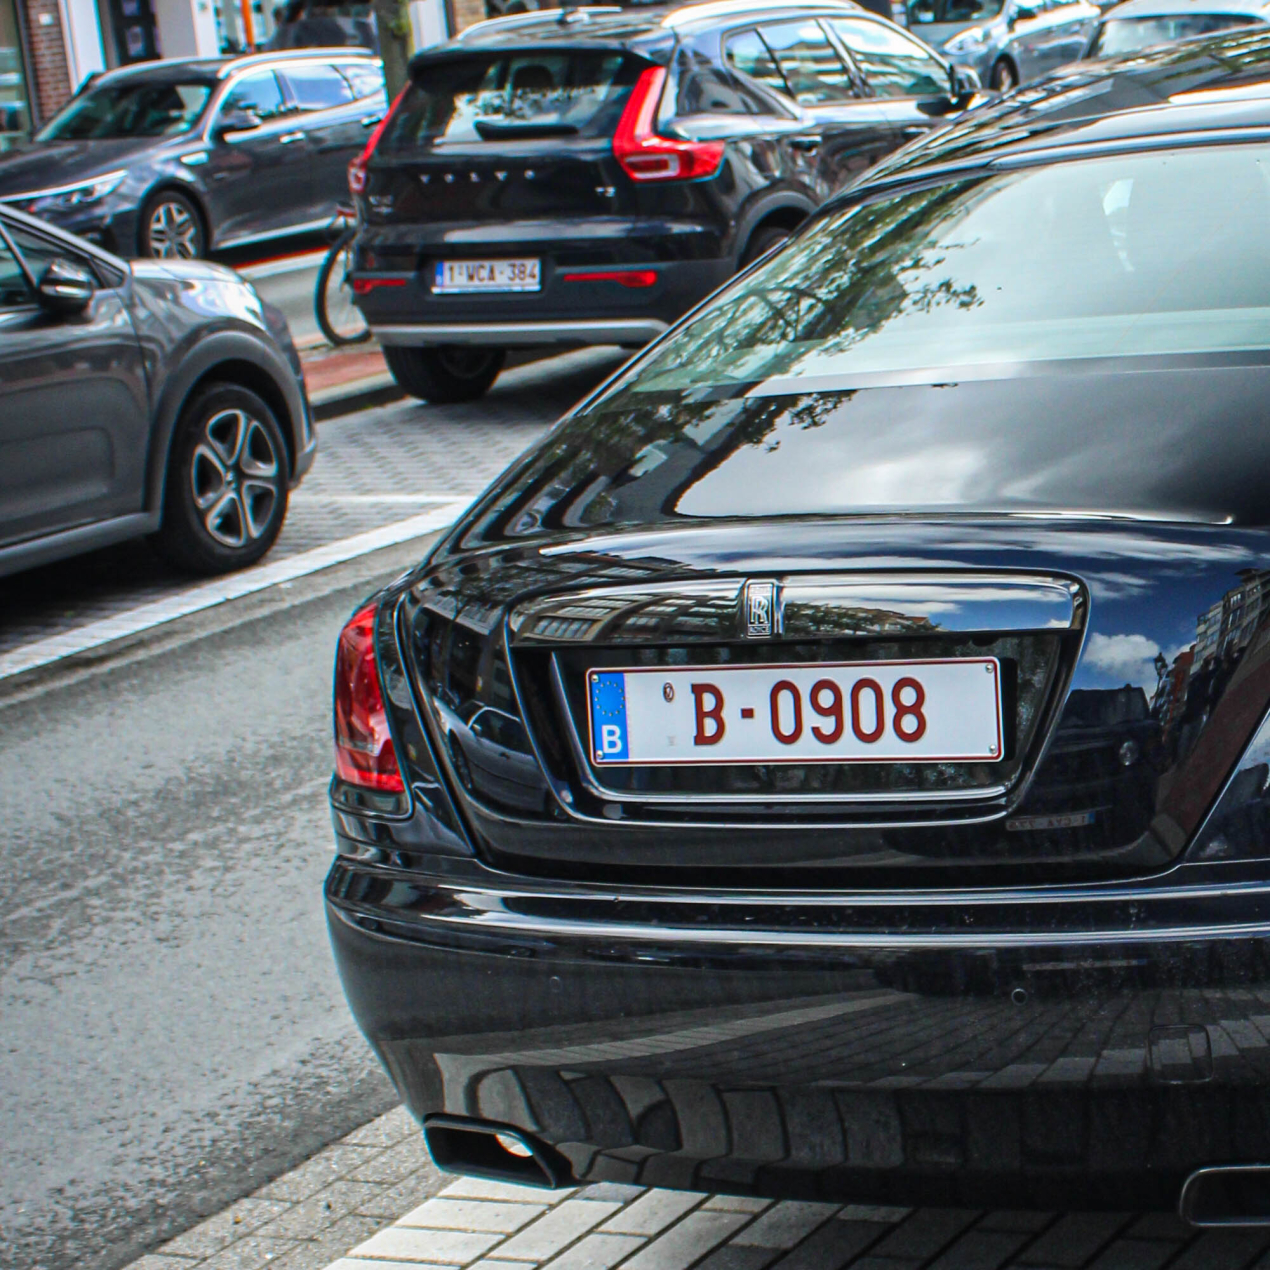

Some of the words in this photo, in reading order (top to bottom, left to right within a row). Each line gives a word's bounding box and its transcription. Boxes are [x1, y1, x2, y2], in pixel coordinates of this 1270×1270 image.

[420, 169, 535, 184] VOLVO
[449, 263, 537, 282] 1-WCA-384
[691, 676, 927, 747] B-0908
[601, 725, 622, 754] B
